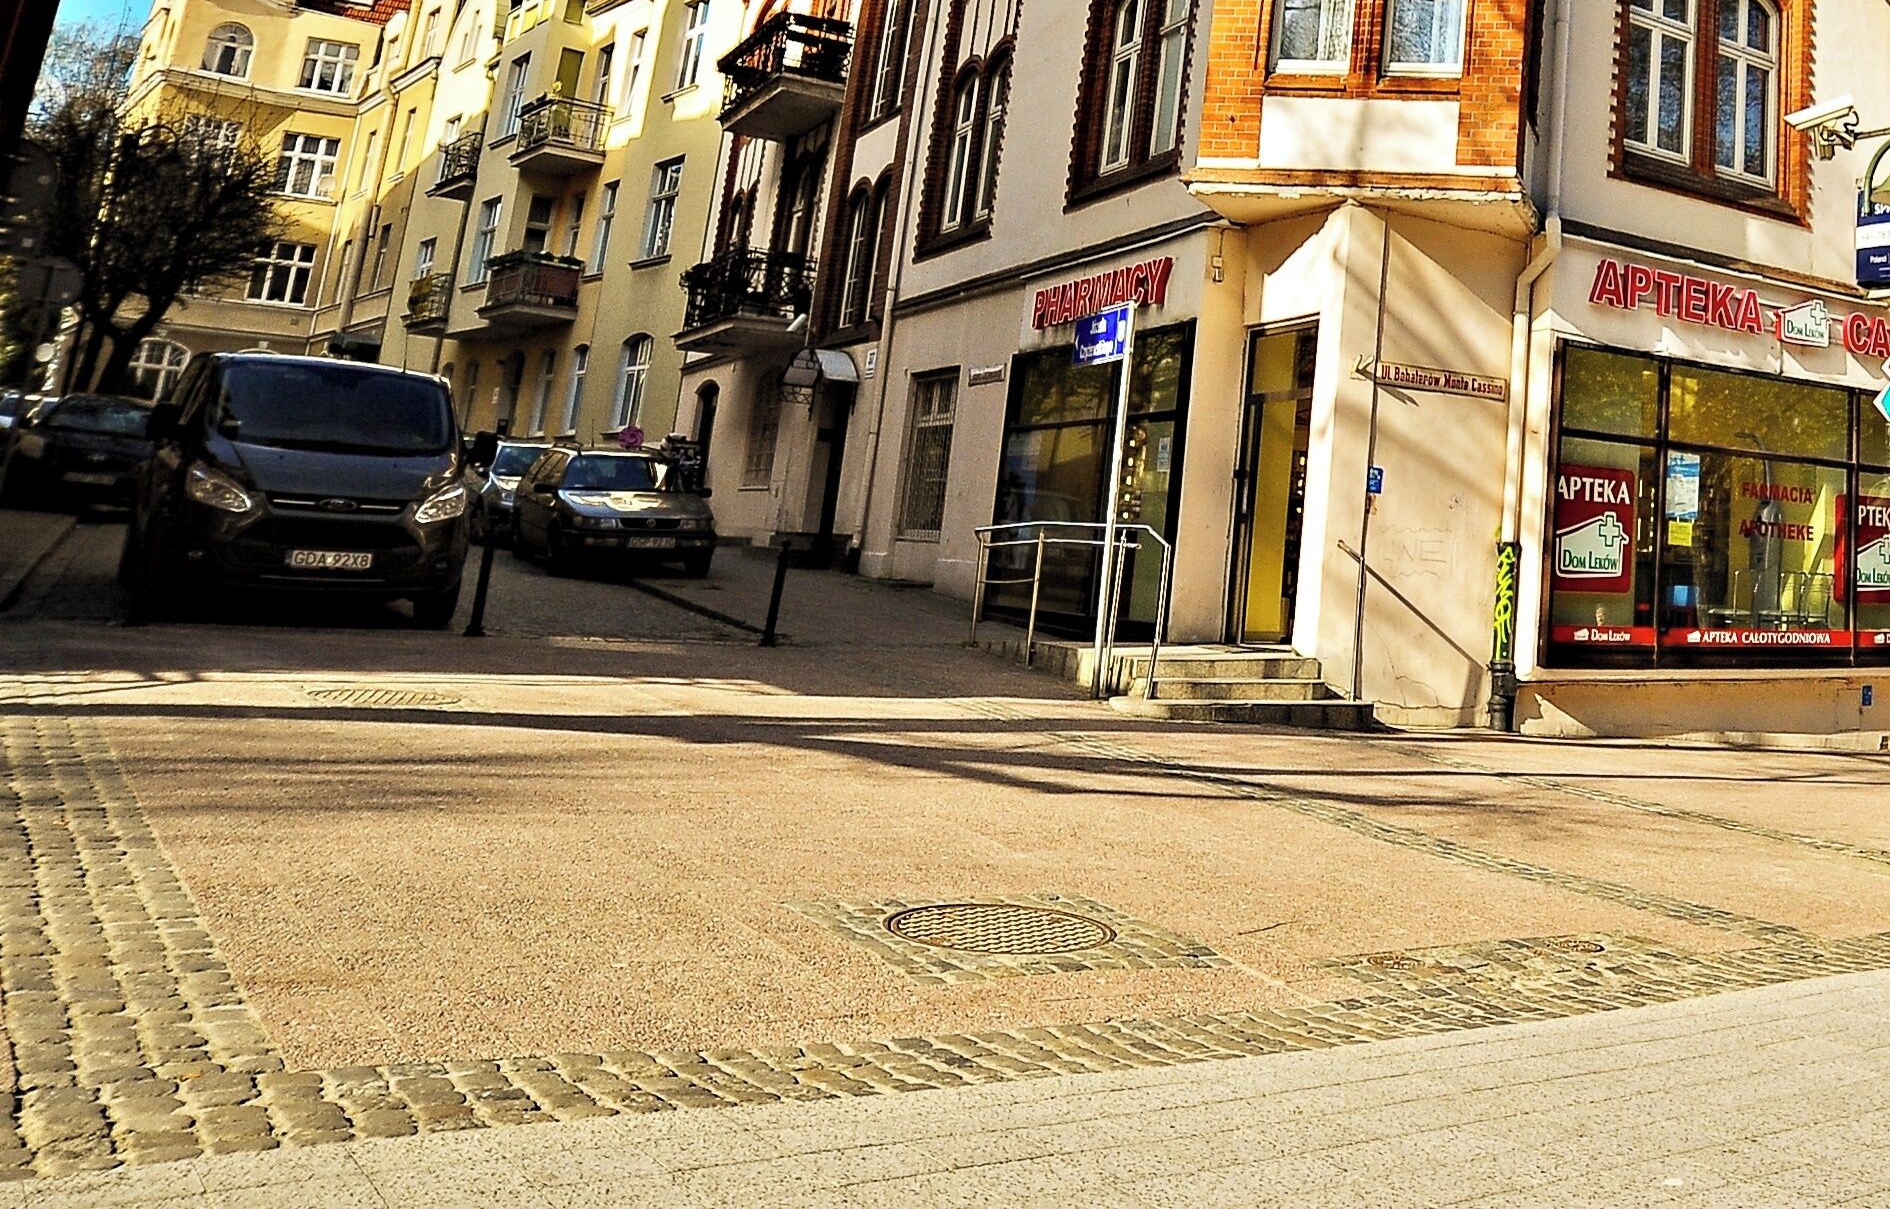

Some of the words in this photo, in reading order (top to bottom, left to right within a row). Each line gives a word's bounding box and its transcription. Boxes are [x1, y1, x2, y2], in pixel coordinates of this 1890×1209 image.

[1032, 256, 1175, 330] PHARMACY
[1588, 259, 1764, 334] APTEKA
[1394, 367, 1441, 387] Bohaterów
[1444, 373, 1469, 391] Monte
[1471, 377, 1503, 396] Cassino
[1558, 475, 1630, 505] APTEKA
[1742, 482, 1813, 504] FARMACIA
[1739, 519, 1814, 542] APOTHEKE
[294, 552, 326, 566] GDA
[333, 553, 369, 567] 92X8
[1702, 630, 1738, 643] APTEKA
